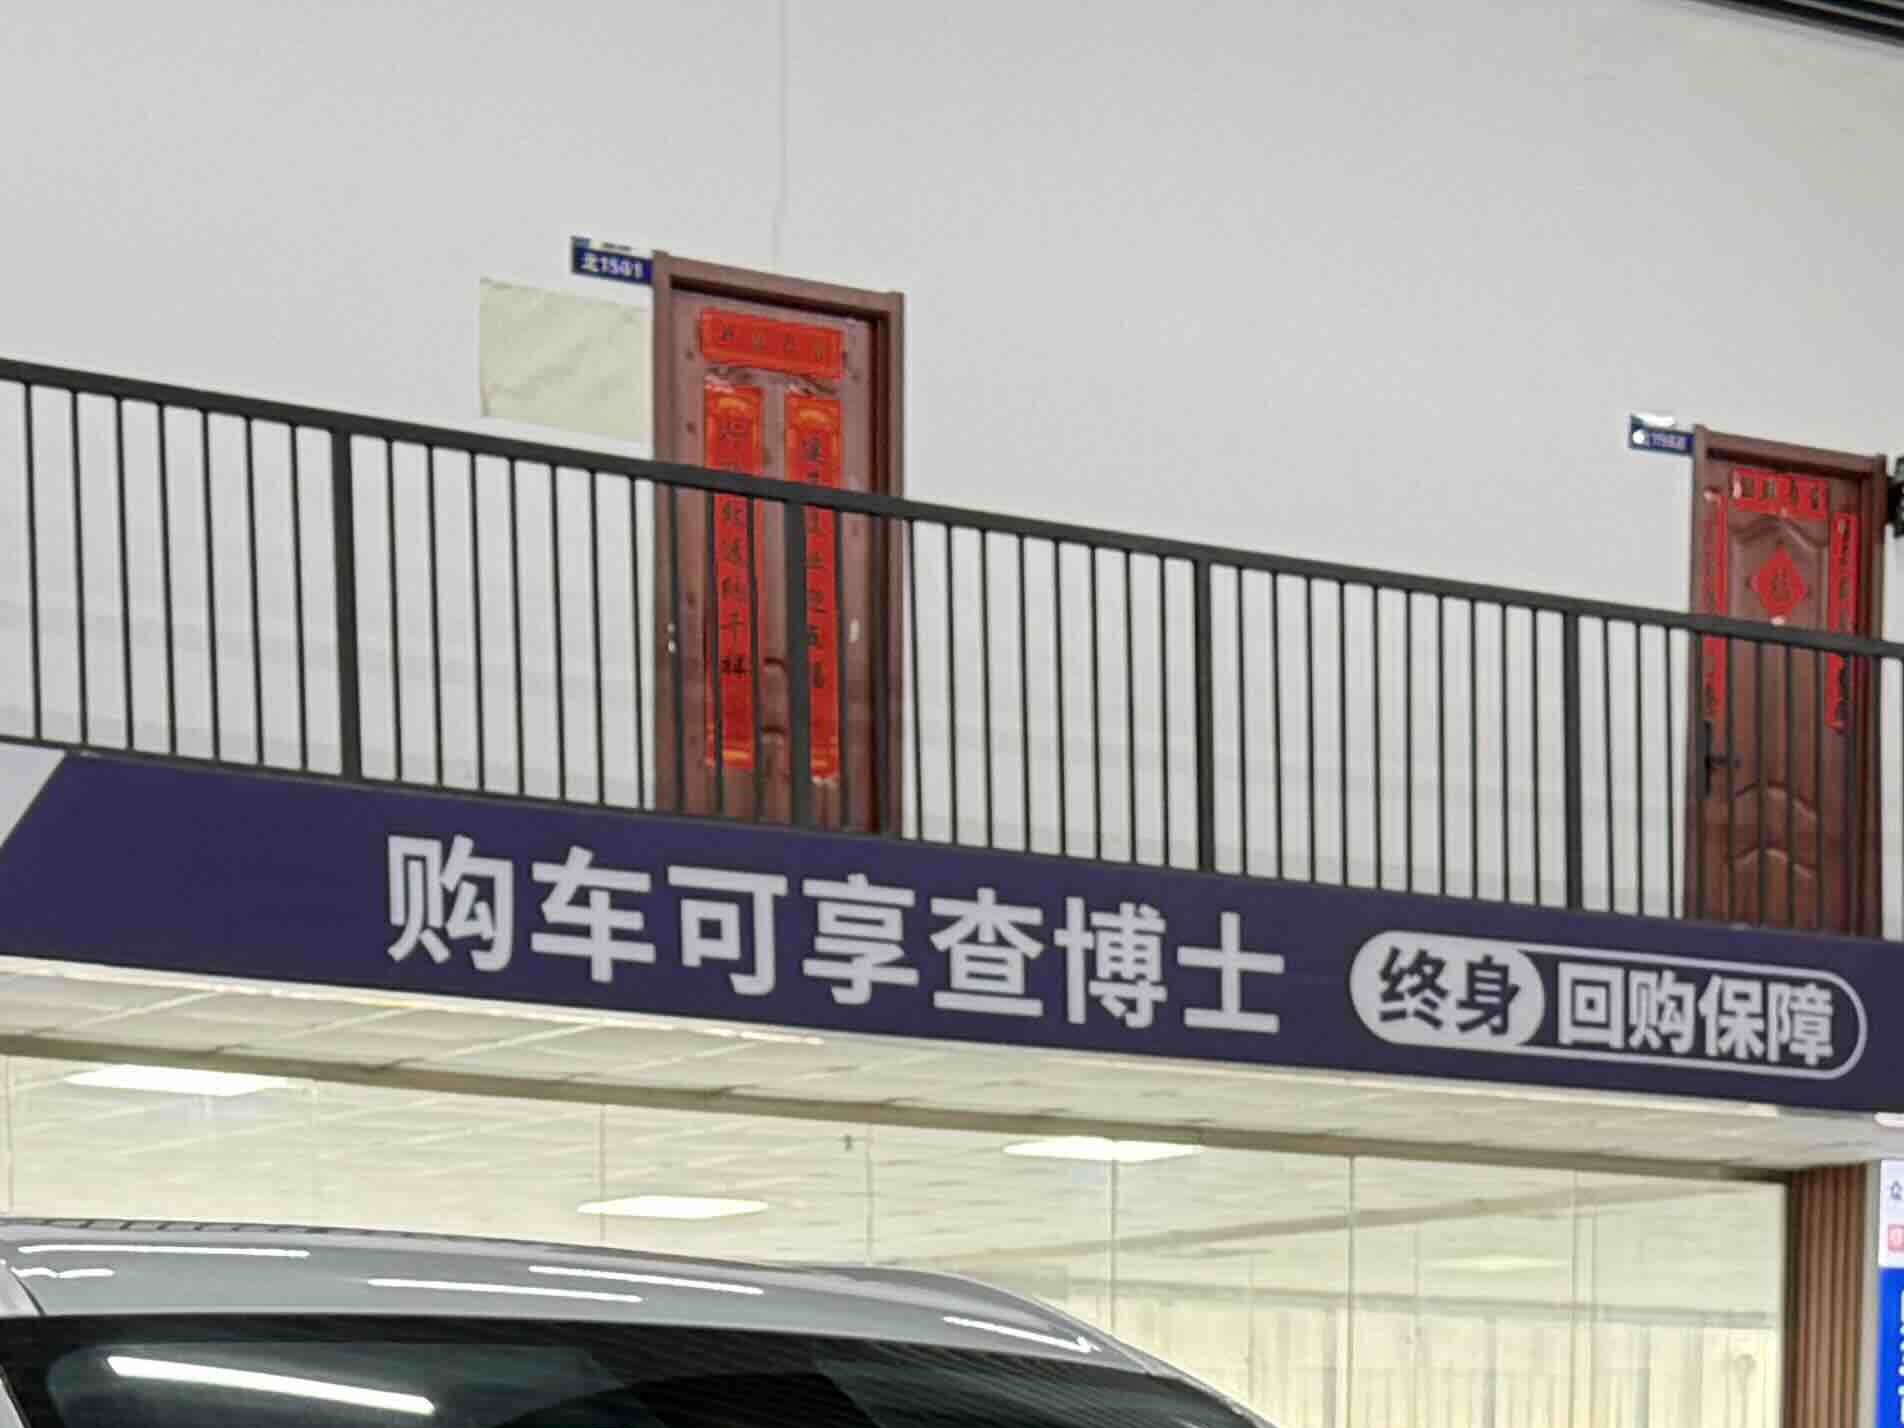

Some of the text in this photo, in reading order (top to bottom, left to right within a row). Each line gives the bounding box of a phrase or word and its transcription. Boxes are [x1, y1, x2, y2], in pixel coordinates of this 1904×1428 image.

[385, 833, 1285, 1035] 购车可享查博士
[1377, 945, 1836, 1068] 终身 回购保障
